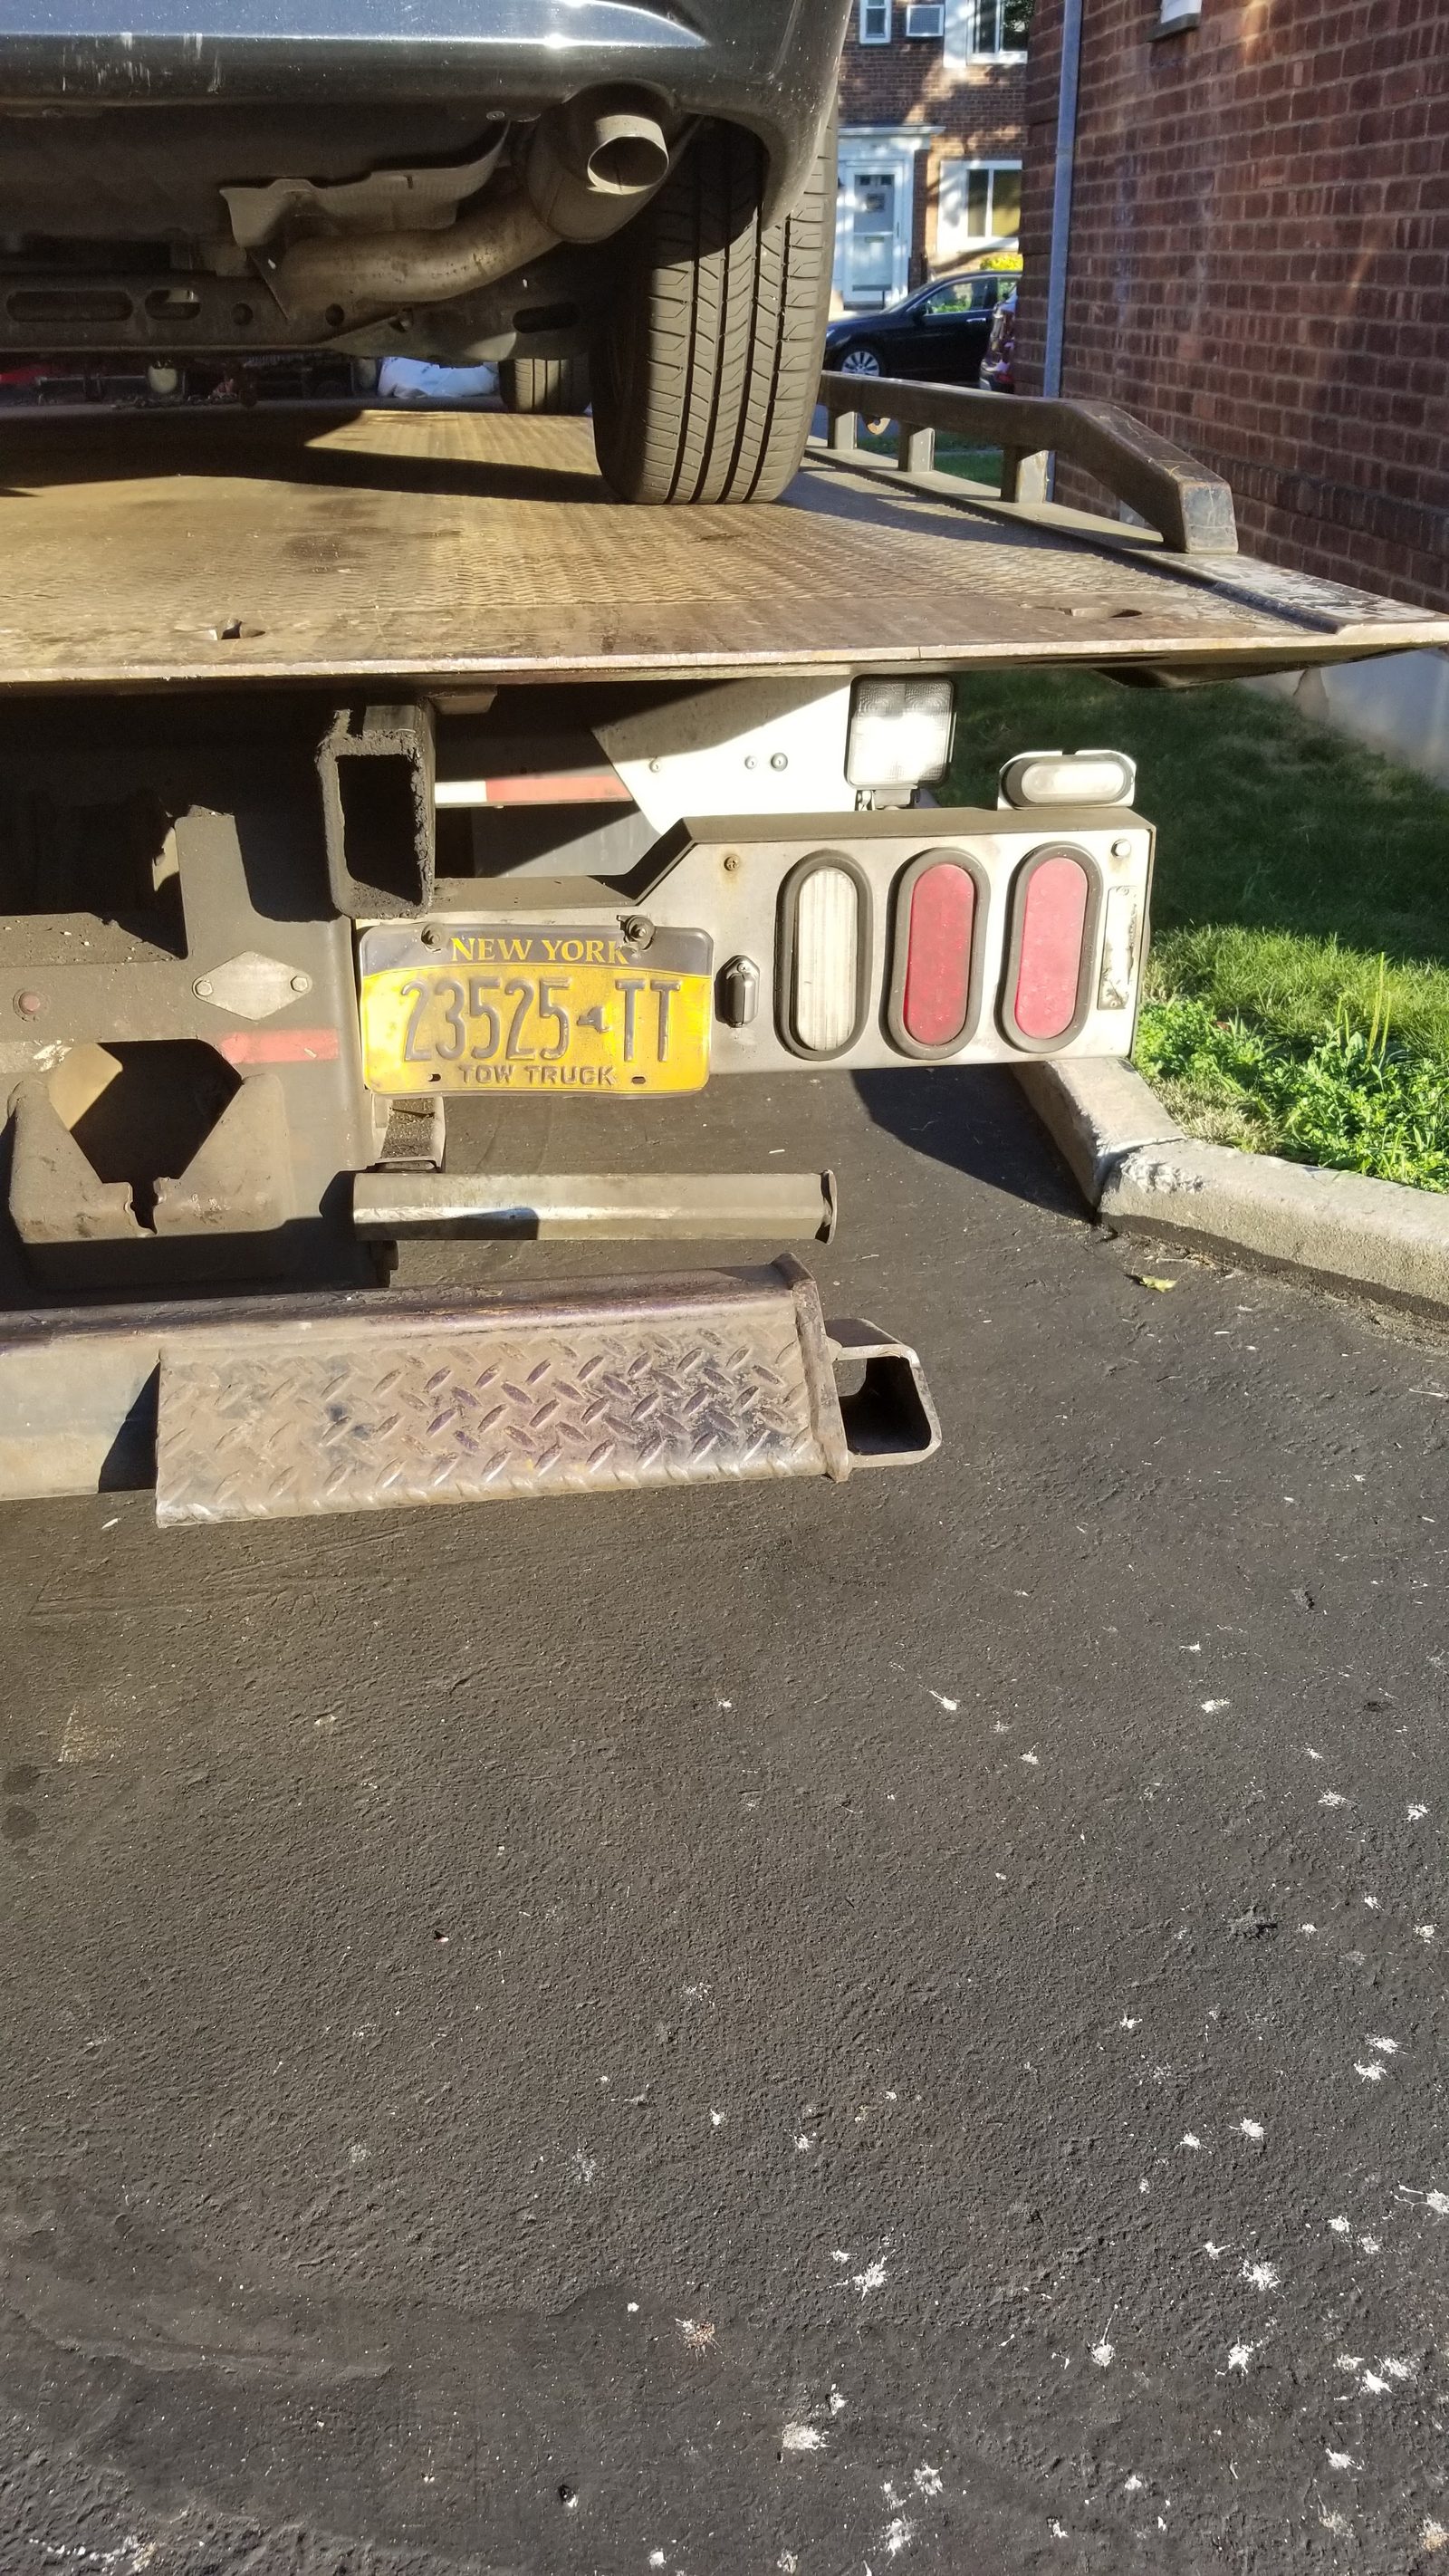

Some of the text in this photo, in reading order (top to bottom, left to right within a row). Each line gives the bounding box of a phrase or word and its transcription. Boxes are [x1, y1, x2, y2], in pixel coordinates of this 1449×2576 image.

[451, 937, 629, 965] NEW YORK
[401, 977, 681, 1062] 23525 TT
[459, 1064, 617, 1086] TOW TRUCK
